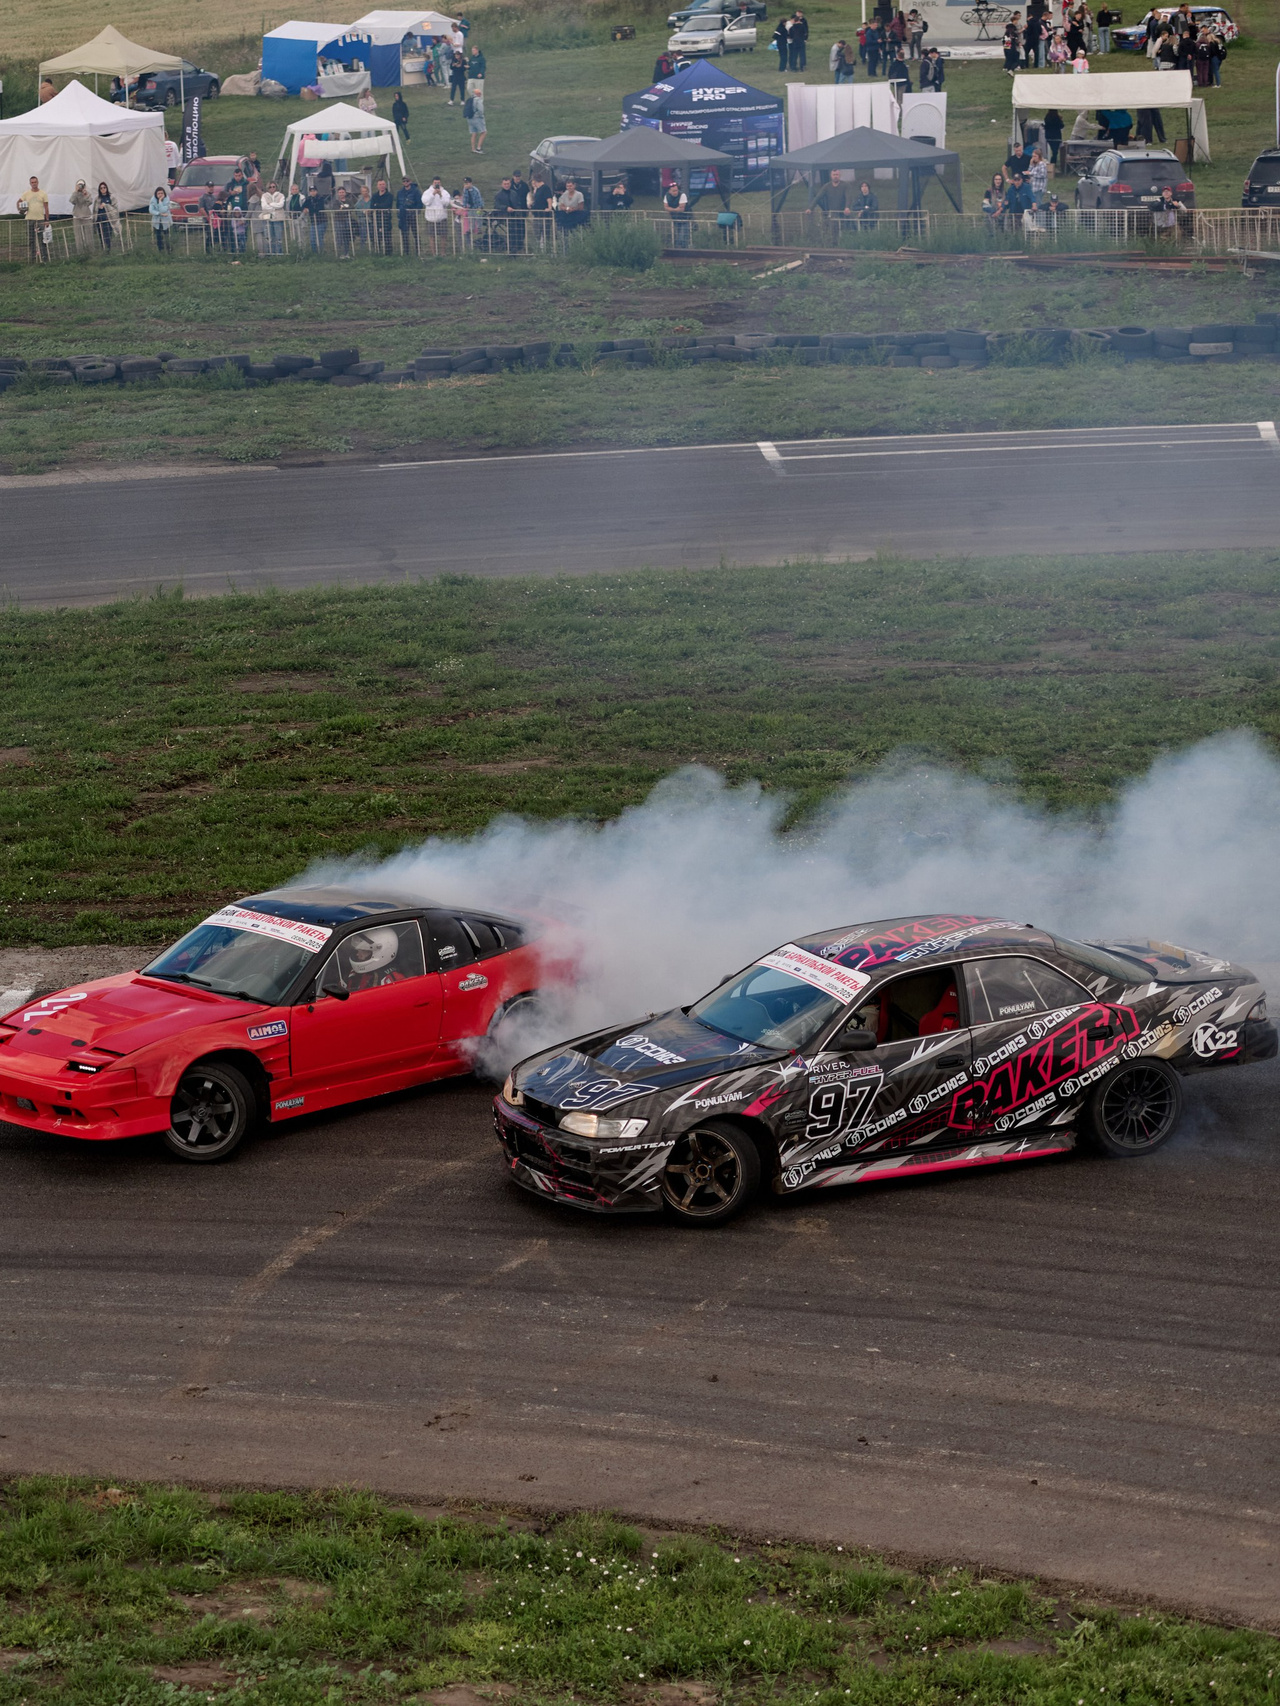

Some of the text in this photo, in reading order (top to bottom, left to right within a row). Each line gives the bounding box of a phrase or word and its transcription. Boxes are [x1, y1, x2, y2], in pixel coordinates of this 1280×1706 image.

[688, 86, 747, 96] HYPER
[692, 93, 727, 101] PRO
[186, 126, 191, 134] В
[235, 910, 297, 930] БАРНАУЛЬСКОЙ
[294, 924, 331, 942] РАКЕТЫ
[305, 938, 323, 949] 2025
[832, 969, 864, 991] РАКЕТЫ
[837, 987, 854, 999] 2025
[250, 1023, 285, 1038] AIMOL
[812, 1061, 851, 1074] RIVER
[558, 1078, 661, 1111] 97
[694, 1091, 744, 1110] PONULYAM
[805, 1072, 884, 1140] 97
